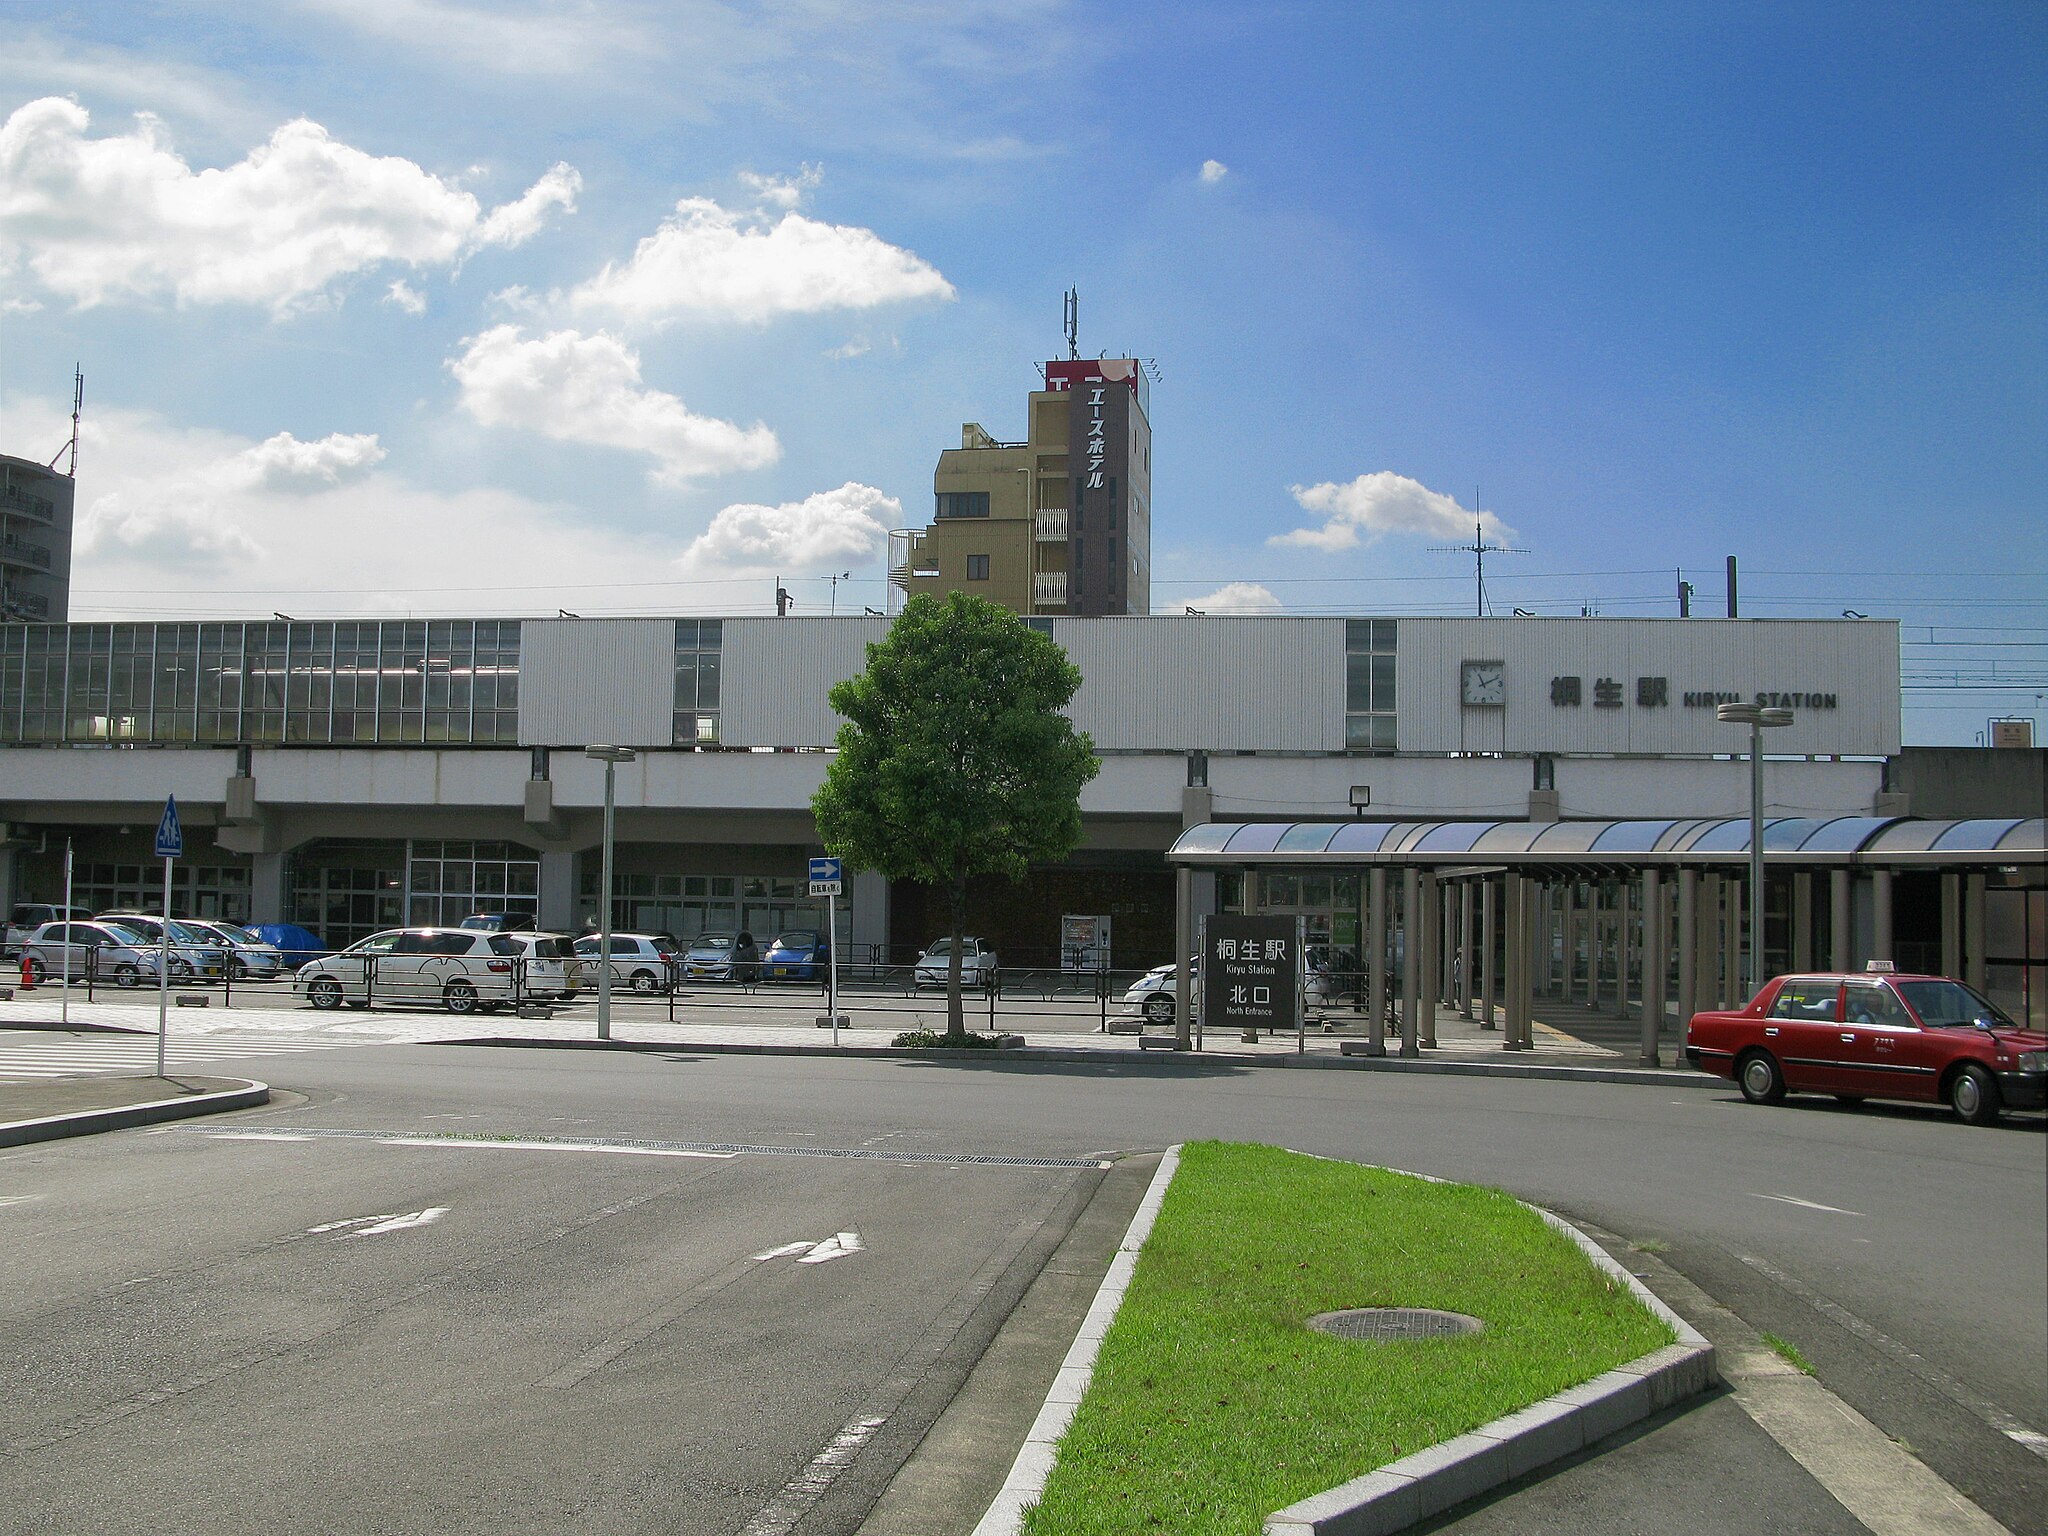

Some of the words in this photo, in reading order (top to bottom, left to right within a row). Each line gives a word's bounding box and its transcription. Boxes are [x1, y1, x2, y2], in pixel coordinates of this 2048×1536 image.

[1086, 388, 1106, 489] エースホテル
[1550, 676, 1668, 708] 桐生駅
[1756, 692, 1837, 709] STATION
[811, 883, 840, 893] 自転車を除く
[1216, 938, 1286, 961] 桐生駅
[1226, 964, 1246, 976] Kiryu
[1248, 964, 1275, 975] Station
[1229, 985, 1270, 1004] 北口
[1226, 1006, 1243, 1016] North
[1245, 1006, 1273, 1016] Entrance
